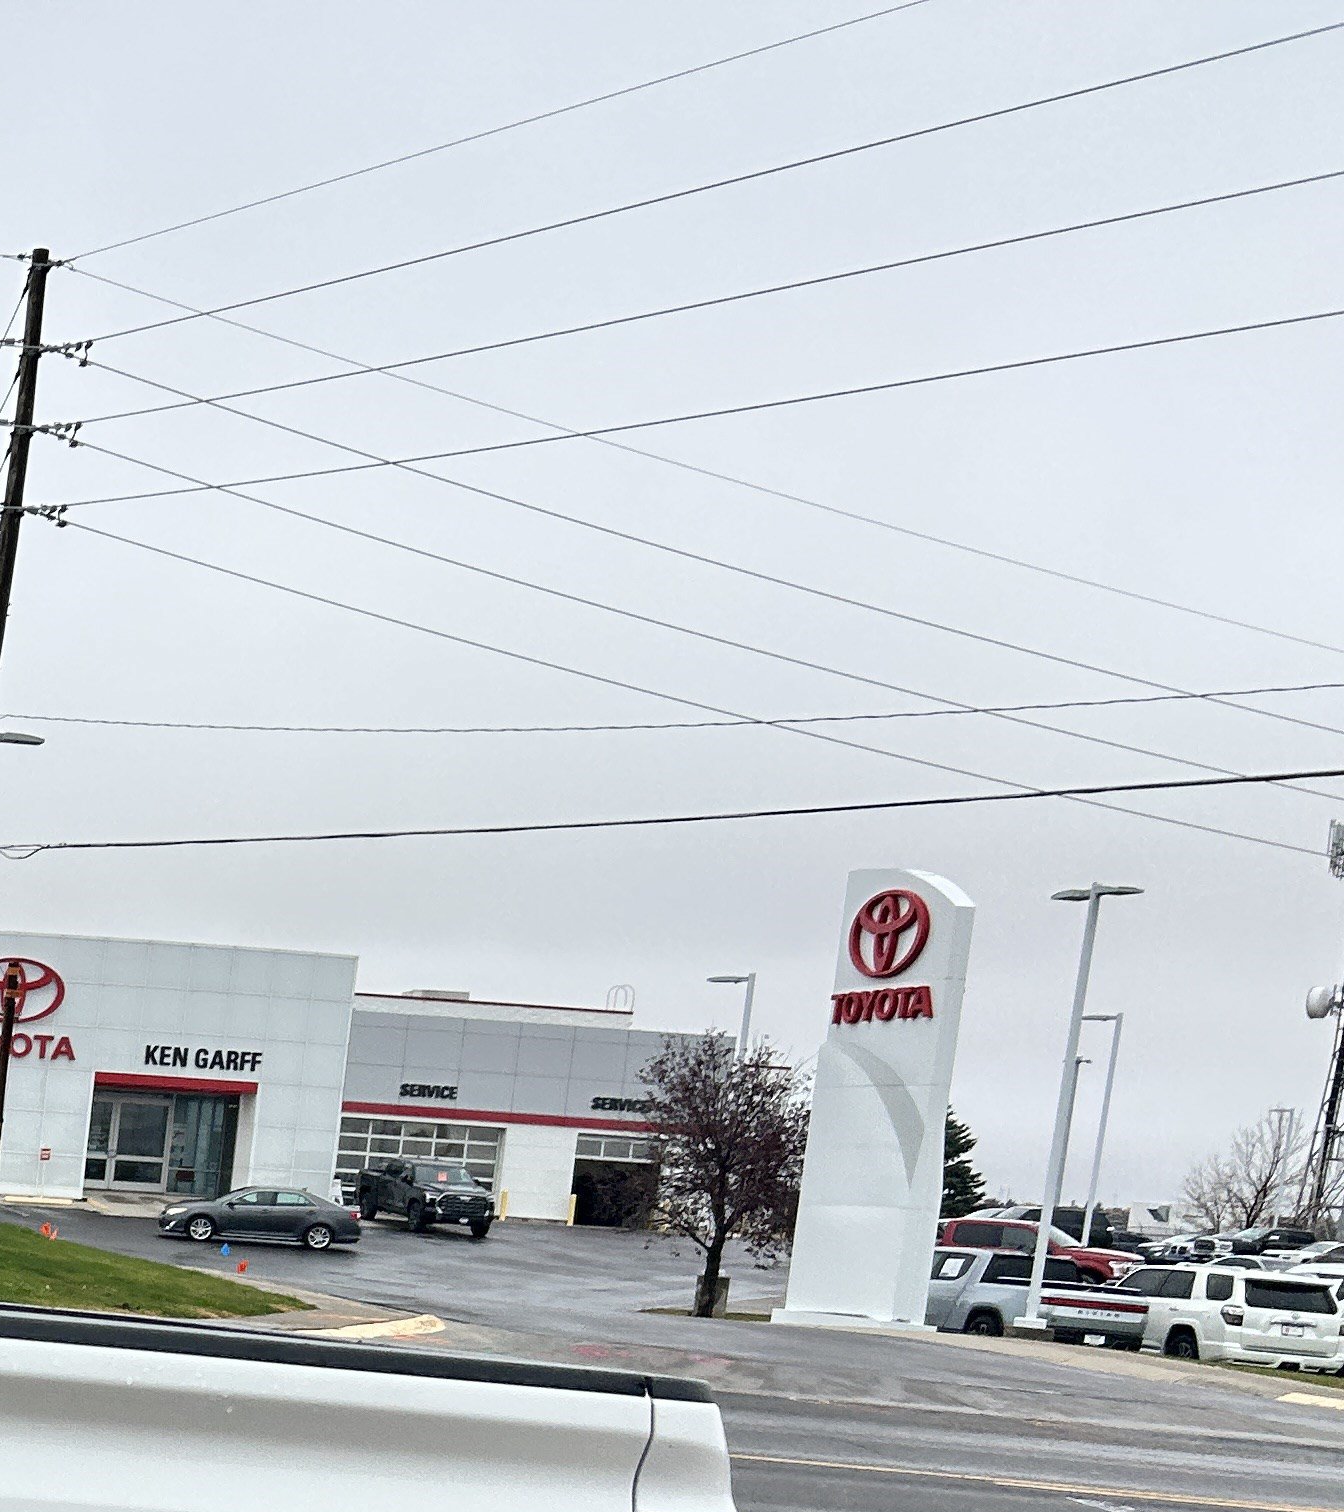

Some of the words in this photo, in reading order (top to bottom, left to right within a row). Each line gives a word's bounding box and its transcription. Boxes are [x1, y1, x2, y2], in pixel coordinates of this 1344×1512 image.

[831, 986, 933, 1024] TOYOTA
[145, 1044, 187, 1067] KEN
[194, 1048, 262, 1072] GARFF
[399, 1083, 458, 1100] SERVICE
